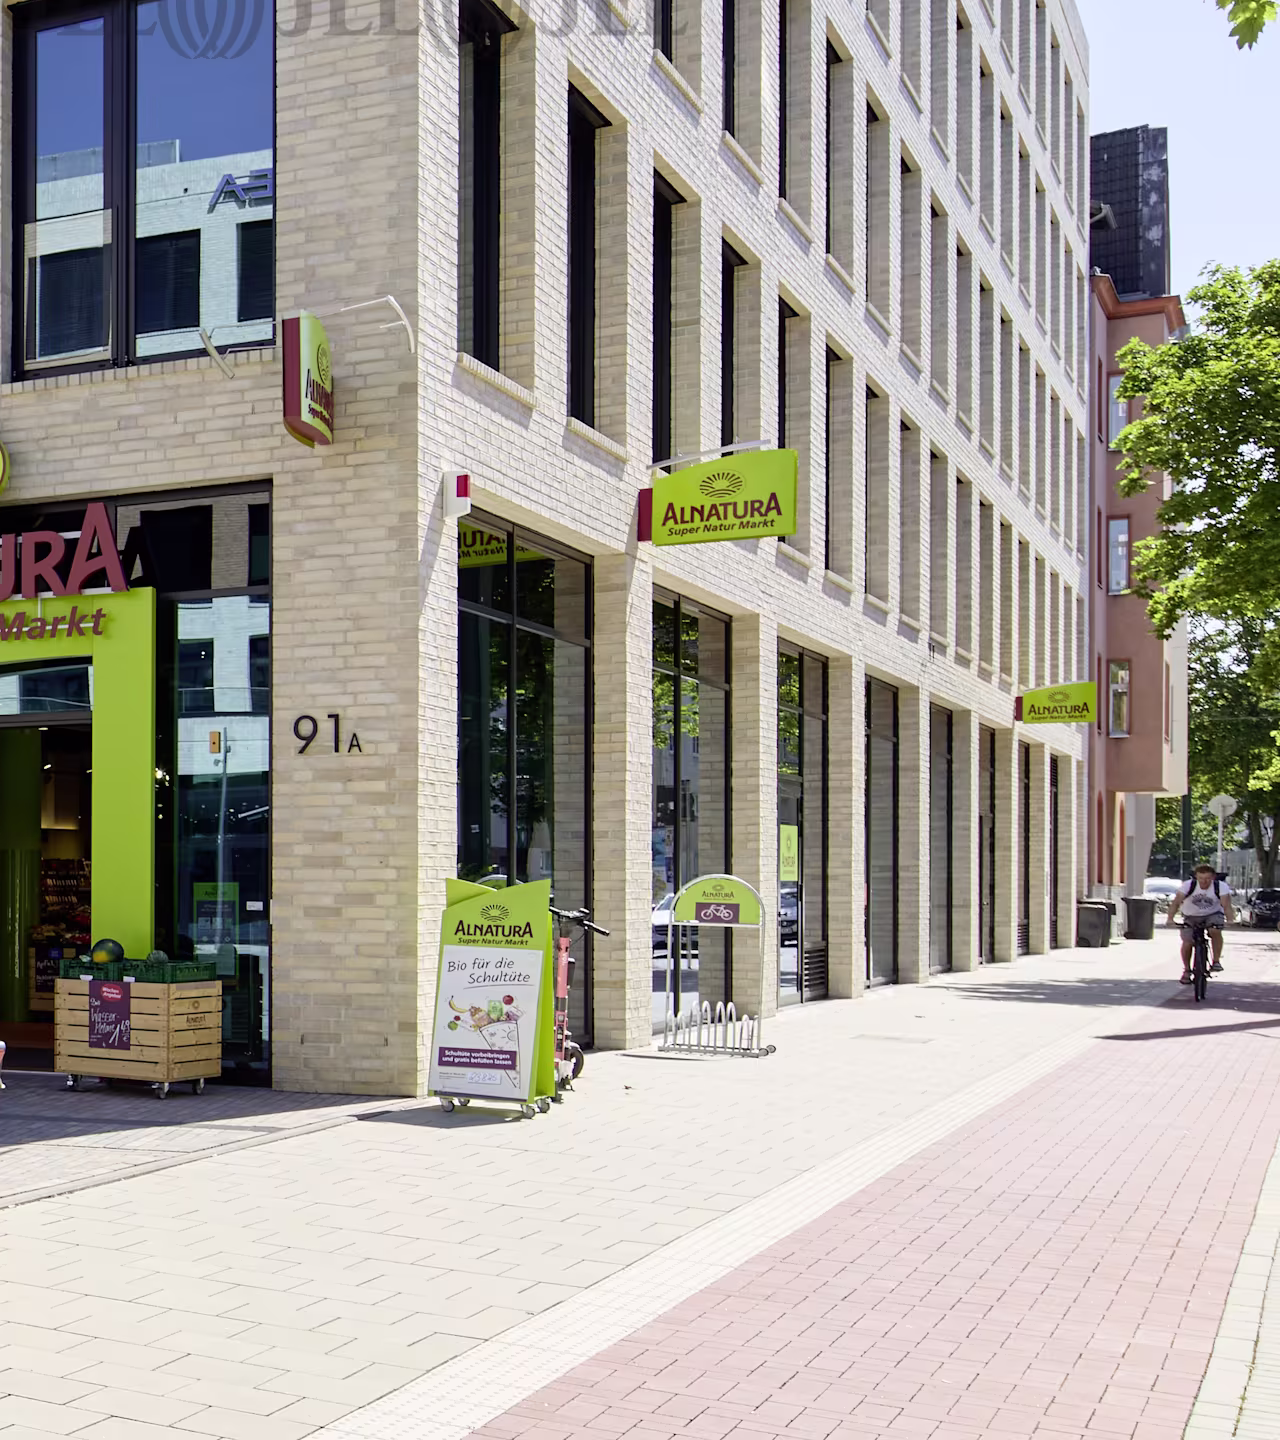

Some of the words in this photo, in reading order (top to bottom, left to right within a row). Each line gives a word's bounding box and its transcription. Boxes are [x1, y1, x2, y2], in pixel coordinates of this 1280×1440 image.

[662, 492, 782, 527] ALNATURA
[667, 526, 700, 537] Super
[702, 521, 736, 533] Natur
[738, 518, 776, 530] Markt
[1028, 702, 1090, 716] ALNATURA
[702, 890, 734, 898] ALNATURA
[454, 920, 533, 938] ALNATURA
[458, 937, 480, 945] Super
[447, 961, 467, 972] Bio
[472, 958, 491, 970] für
[494, 957, 514, 969] die
[467, 971, 531, 984] Schultüte
